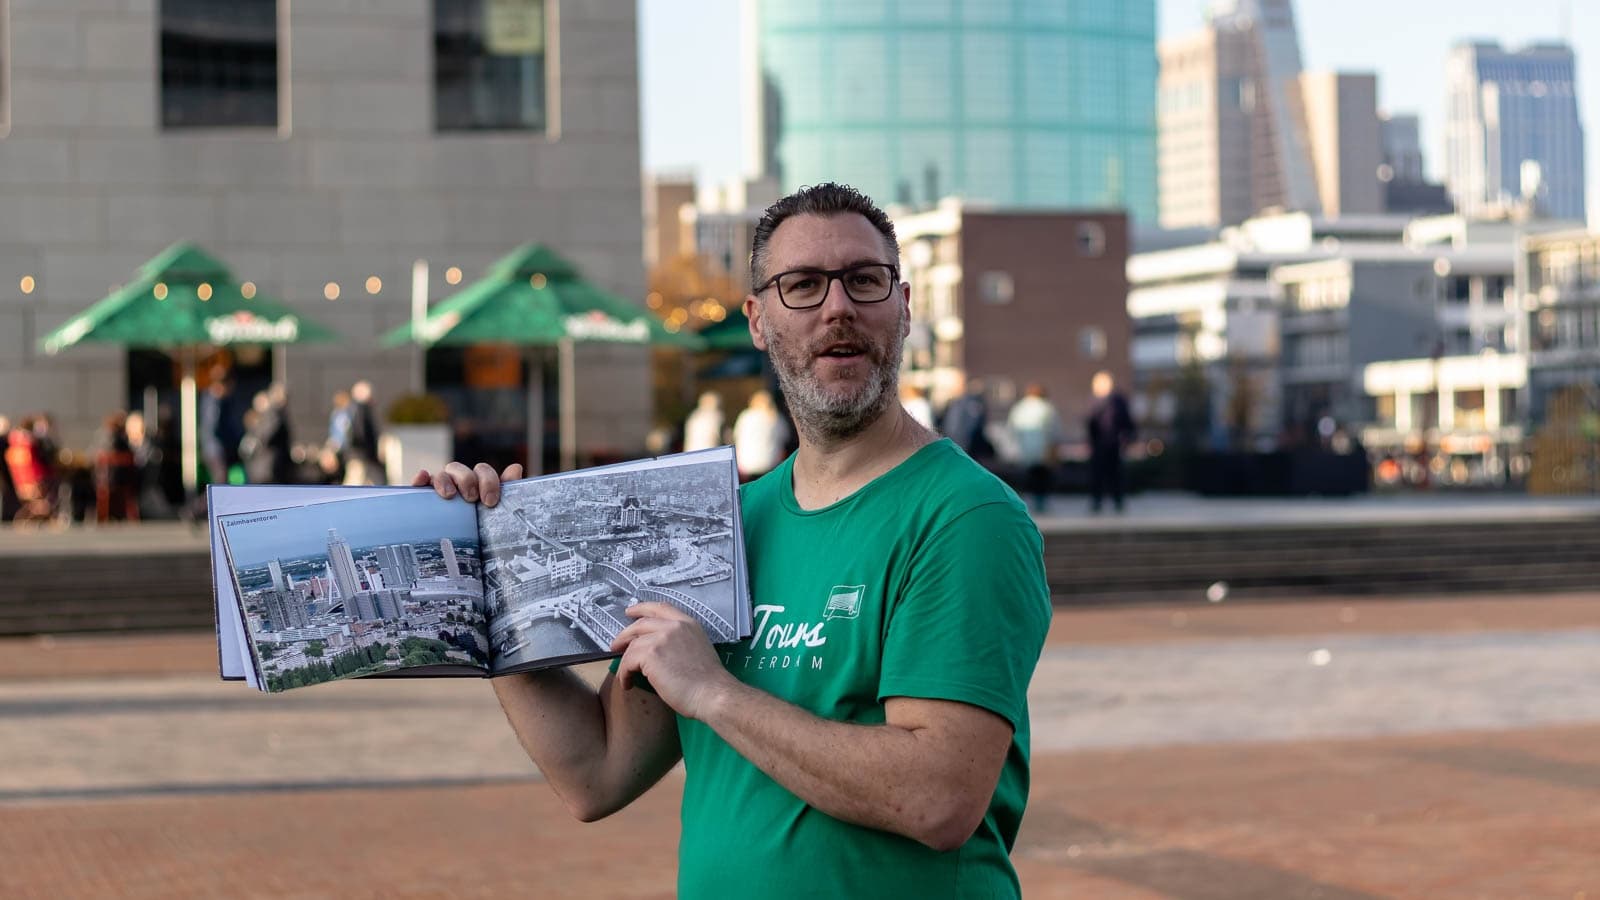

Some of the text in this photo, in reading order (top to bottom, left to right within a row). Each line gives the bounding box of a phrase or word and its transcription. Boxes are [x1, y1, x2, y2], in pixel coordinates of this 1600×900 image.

[226, 514, 278, 527] Zalmhaventoren
[750, 604, 826, 650] Tours
[725, 652, 823, 670] TTERDM
